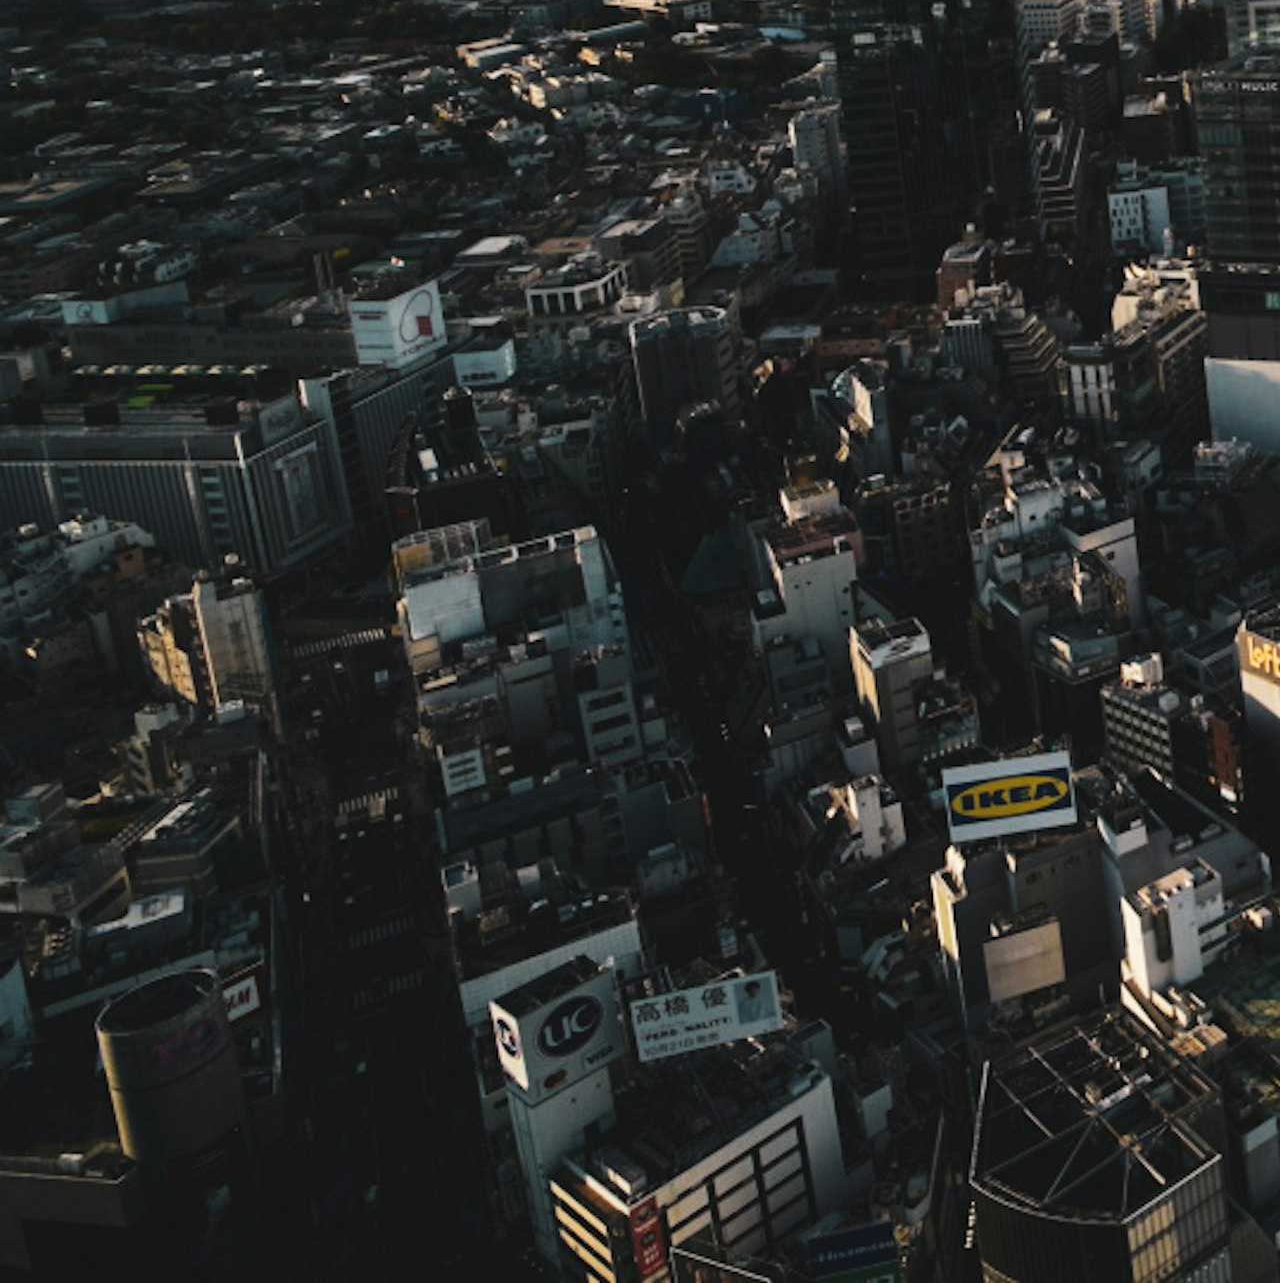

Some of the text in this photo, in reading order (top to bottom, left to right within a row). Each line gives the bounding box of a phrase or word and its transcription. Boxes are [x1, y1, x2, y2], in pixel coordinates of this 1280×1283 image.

[962, 781, 1059, 811] IKEA
[637, 987, 728, 1024] 高橋 優
[543, 1003, 599, 1048] UC
